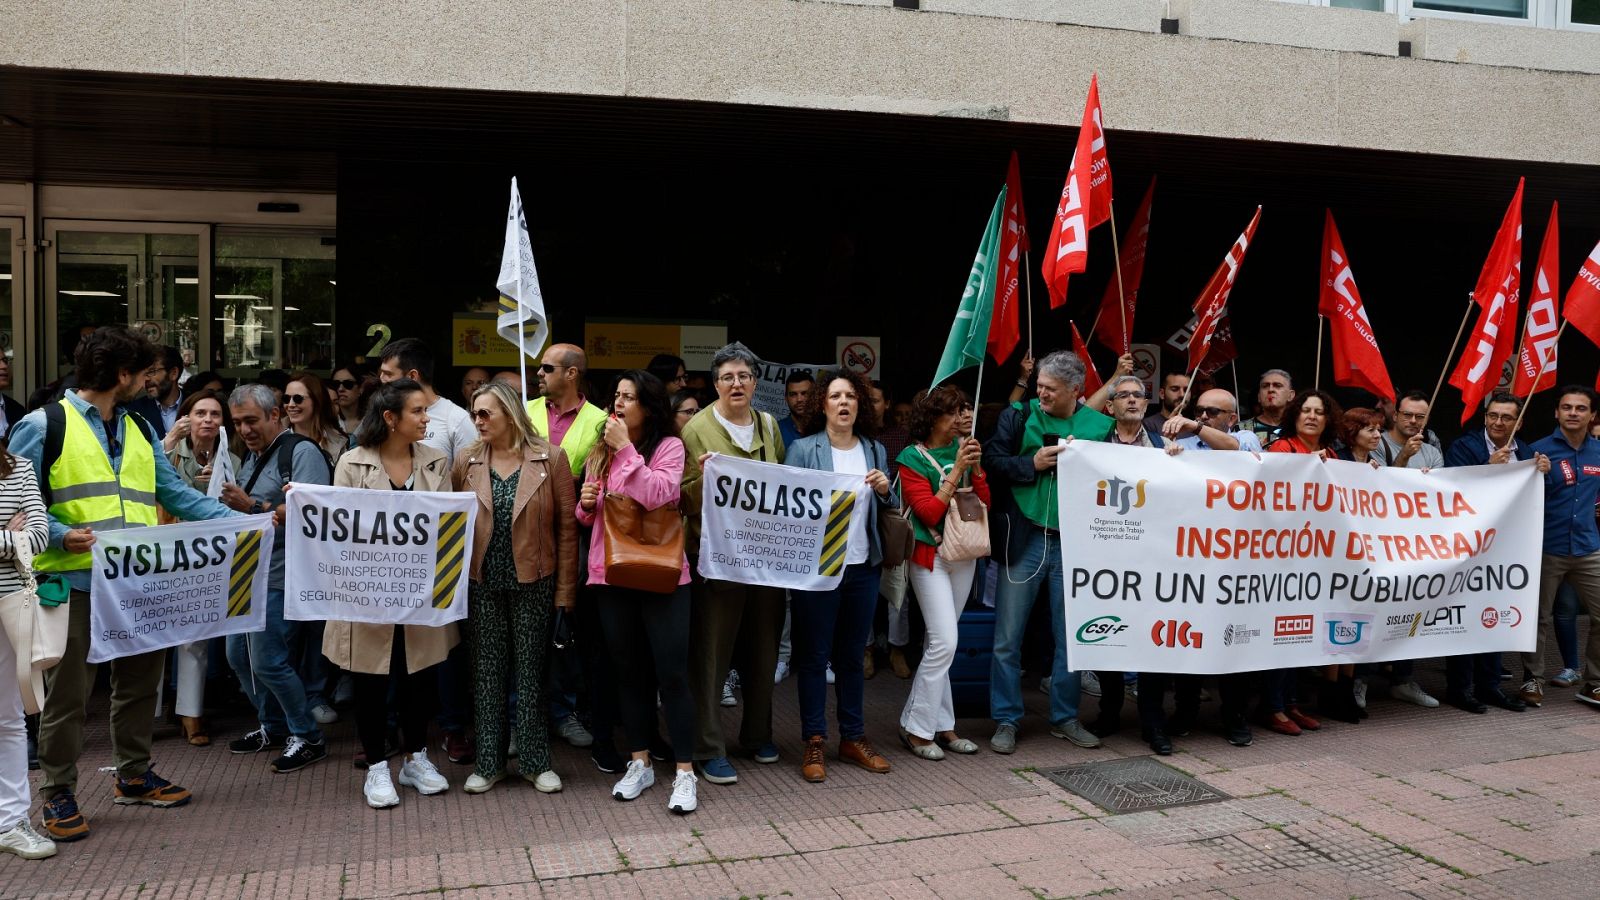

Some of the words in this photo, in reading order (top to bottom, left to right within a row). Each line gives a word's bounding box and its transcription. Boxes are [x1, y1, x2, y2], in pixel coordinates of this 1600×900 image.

[365, 323, 391, 357] 2
[1344, 308, 1354, 321] la
[1354, 321, 1380, 352] ciuda
[714, 475, 823, 521] SISLASS
[1205, 478, 1267, 511] POR
[1273, 481, 1297, 511] EL
[1302, 482, 1388, 519] FUTURO
[1393, 491, 1432, 519] DE
[1436, 491, 1477, 518] LA
[302, 504, 430, 546] SISLASS
[744, 518, 802, 534] SINDICATO
[805, 526, 818, 536] DE
[1094, 517, 1124, 526] Organismo
[1126, 526, 1145, 534] Trabajo
[724, 529, 816, 549] SUBINSPECTORES
[1176, 521, 1336, 559] INSPECCIÓN
[1345, 531, 1376, 562] DE
[1378, 527, 1497, 562] TRABAJO
[103, 535, 228, 580] SISLASS
[340, 550, 408, 564] SINDICATO
[411, 553, 428, 565] DE
[709, 552, 764, 569] EGURIDAD
[764, 561, 773, 570] Y
[776, 562, 811, 575] SALUD
[736, 544, 796, 560] LABORALES
[798, 551, 814, 562] DE
[318, 562, 427, 579] SUBINSPECTORES
[142, 574, 204, 594] SINDICATO
[208, 572, 223, 582] DE
[334, 579, 406, 593] LABORALES
[410, 583, 426, 594] DE
[1071, 567, 1142, 601] POR
[1155, 572, 1205, 604] UN
[1216, 571, 1321, 605] SERVICIO
[1329, 567, 1446, 603] PÚBLICO
[1447, 563, 1529, 596] DIGNO
[119, 584, 221, 611] SUBINSPECTORES
[300, 590, 370, 607] SEGURIDAD
[372, 597, 381, 607] Y
[384, 597, 424, 609] SALUD
[134, 602, 201, 622] LABORALES
[204, 598, 220, 609] DE
[1386, 613, 1415, 626] SISLASS
[102, 620, 167, 642] SEGURIDAD
[170, 618, 178, 629] Y
[180, 611, 220, 626] SALUD
[1151, 619, 1204, 649] CIG
[1276, 618, 1312, 632] CCOO
